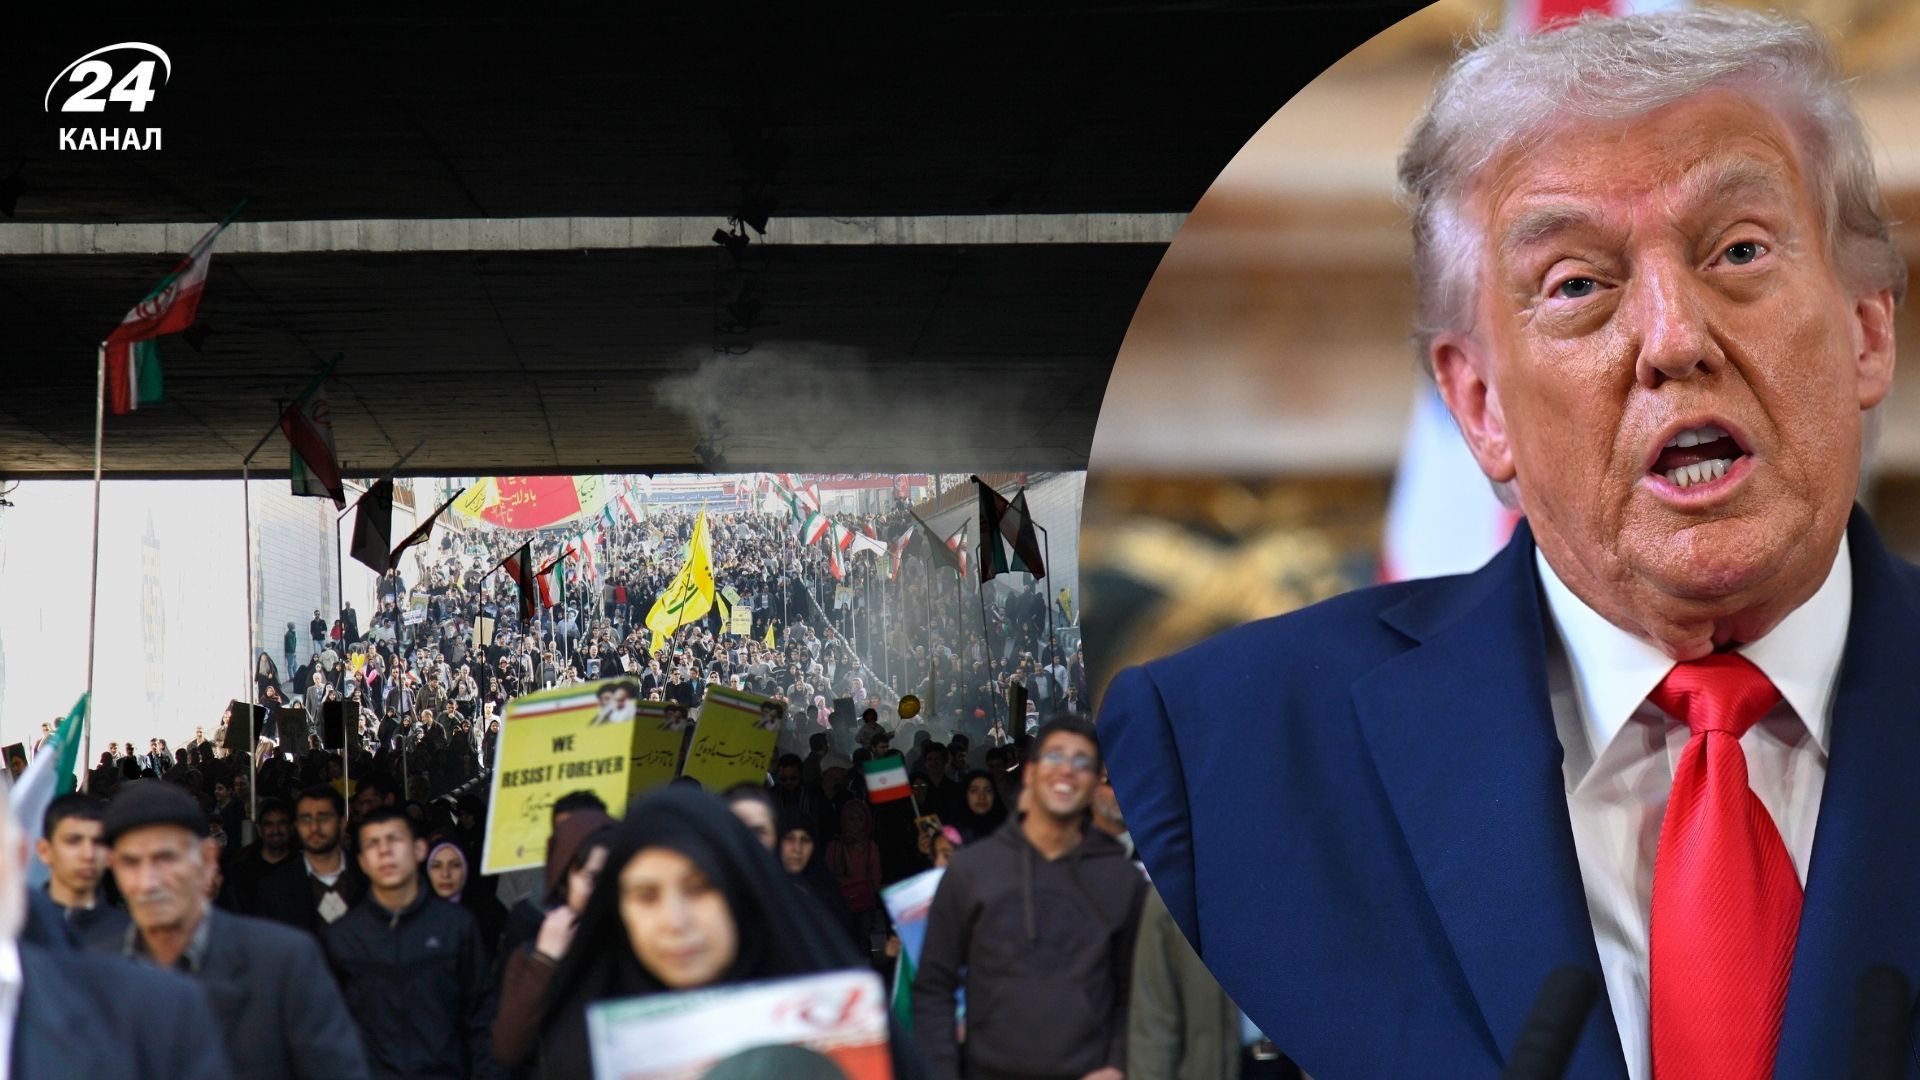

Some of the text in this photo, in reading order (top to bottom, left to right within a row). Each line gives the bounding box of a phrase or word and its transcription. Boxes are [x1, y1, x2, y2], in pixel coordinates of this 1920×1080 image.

[552, 734, 576, 753] WE
[502, 765, 553, 788] RESIST
[558, 756, 624, 780] FOREVER
